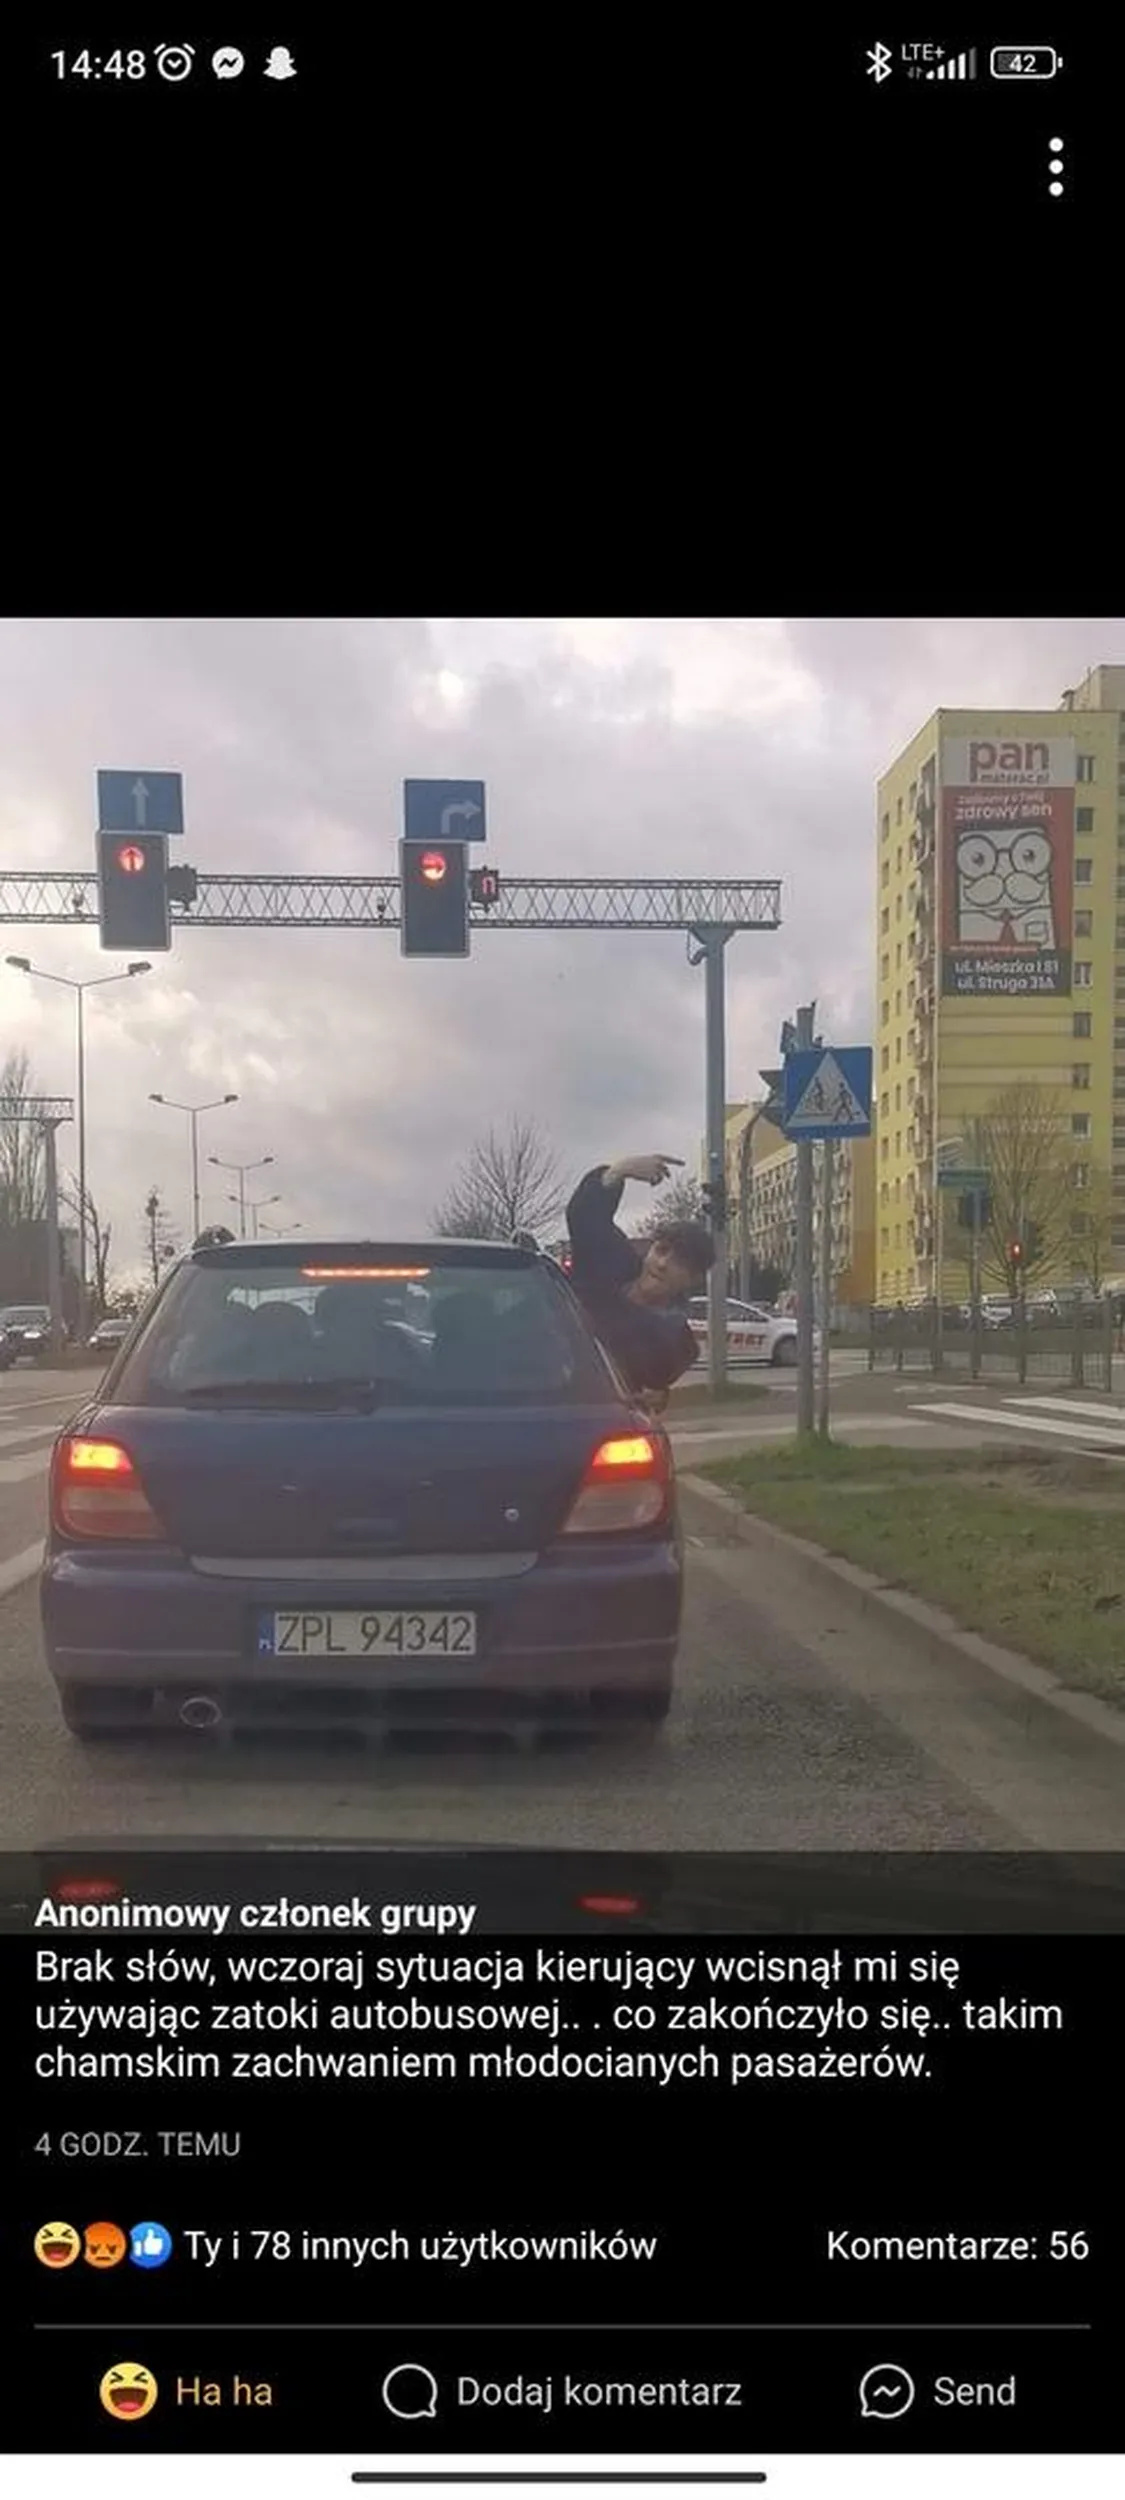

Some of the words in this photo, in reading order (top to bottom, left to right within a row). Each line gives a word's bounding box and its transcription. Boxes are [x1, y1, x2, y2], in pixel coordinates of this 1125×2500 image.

[969, 742, 1049, 782] pan
[954, 804, 1019, 821] zdrowy
[1020, 804, 1053, 818] sen
[277, 1615, 347, 1653] ZPL
[360, 1615, 472, 1653] 94342
